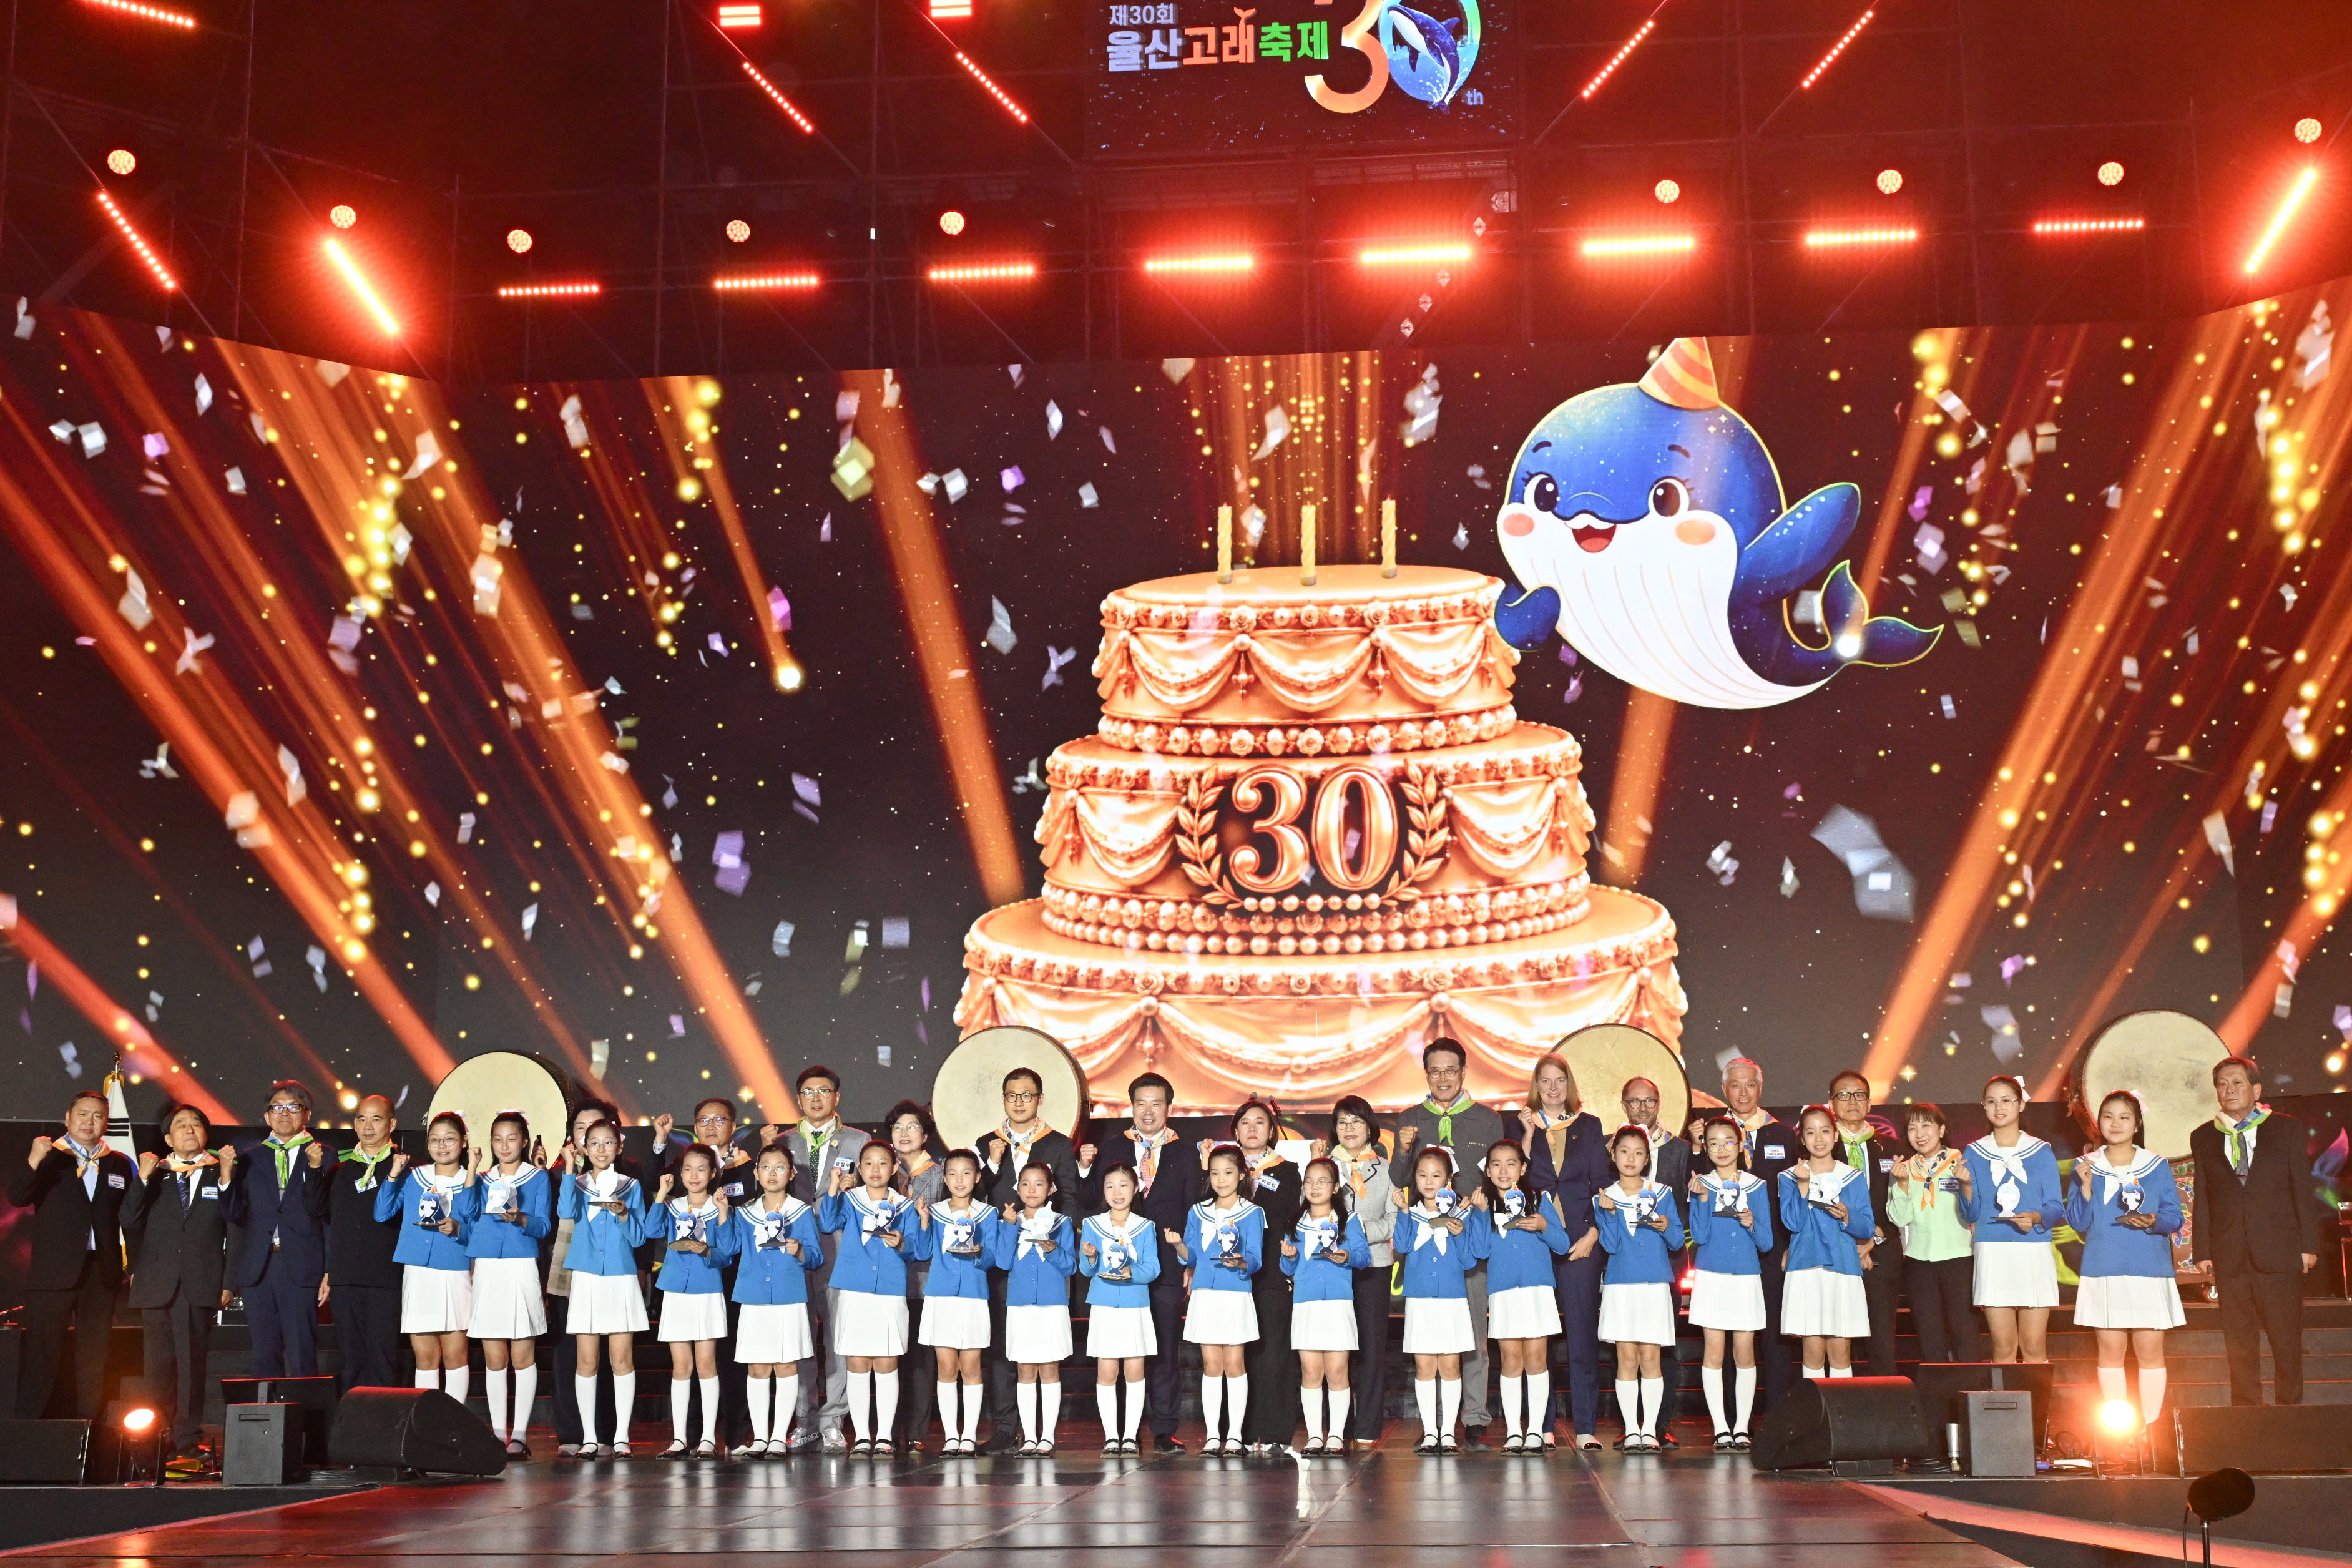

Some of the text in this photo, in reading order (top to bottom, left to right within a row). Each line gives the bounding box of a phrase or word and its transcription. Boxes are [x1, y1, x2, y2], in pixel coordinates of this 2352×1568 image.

[1109, 2, 1174, 26] 제30회
[1466, 88, 1484, 105] th
[1229, 762, 1398, 893] 30
[797, 1431, 820, 1446] TERREX
